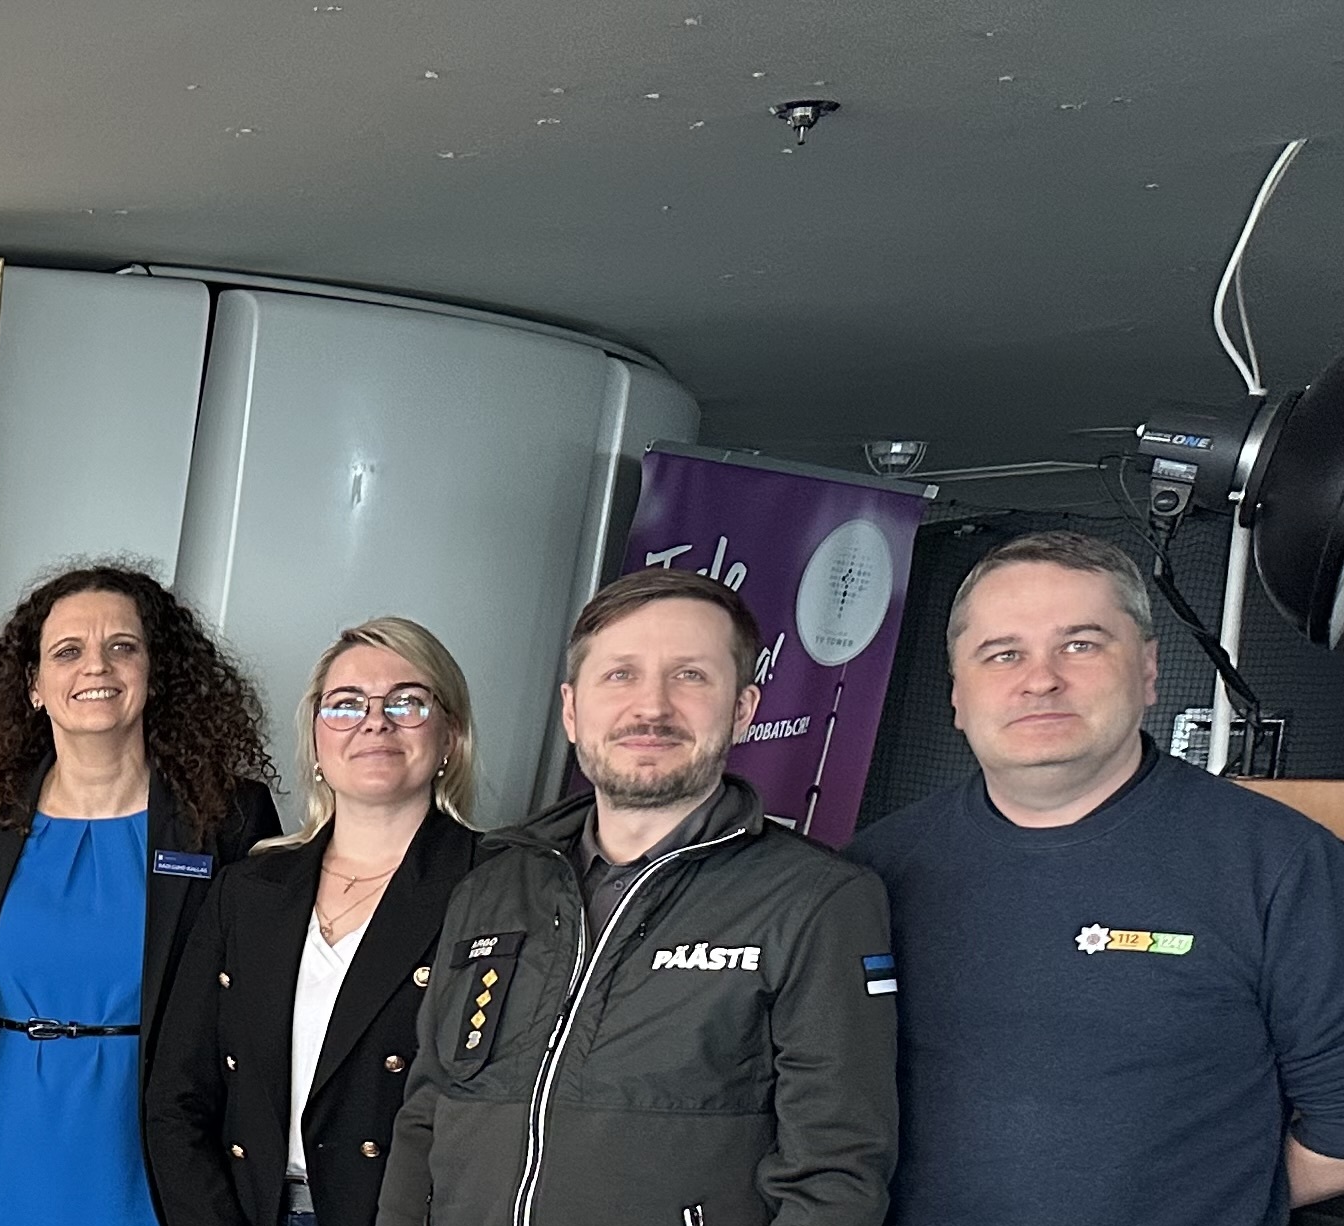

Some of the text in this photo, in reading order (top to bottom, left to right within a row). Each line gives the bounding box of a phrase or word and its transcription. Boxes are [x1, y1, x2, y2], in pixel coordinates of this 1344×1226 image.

[1171, 434, 1212, 449] ONE
[1118, 933, 1140, 944] 112
[652, 942, 761, 971] PÄÄSTE
